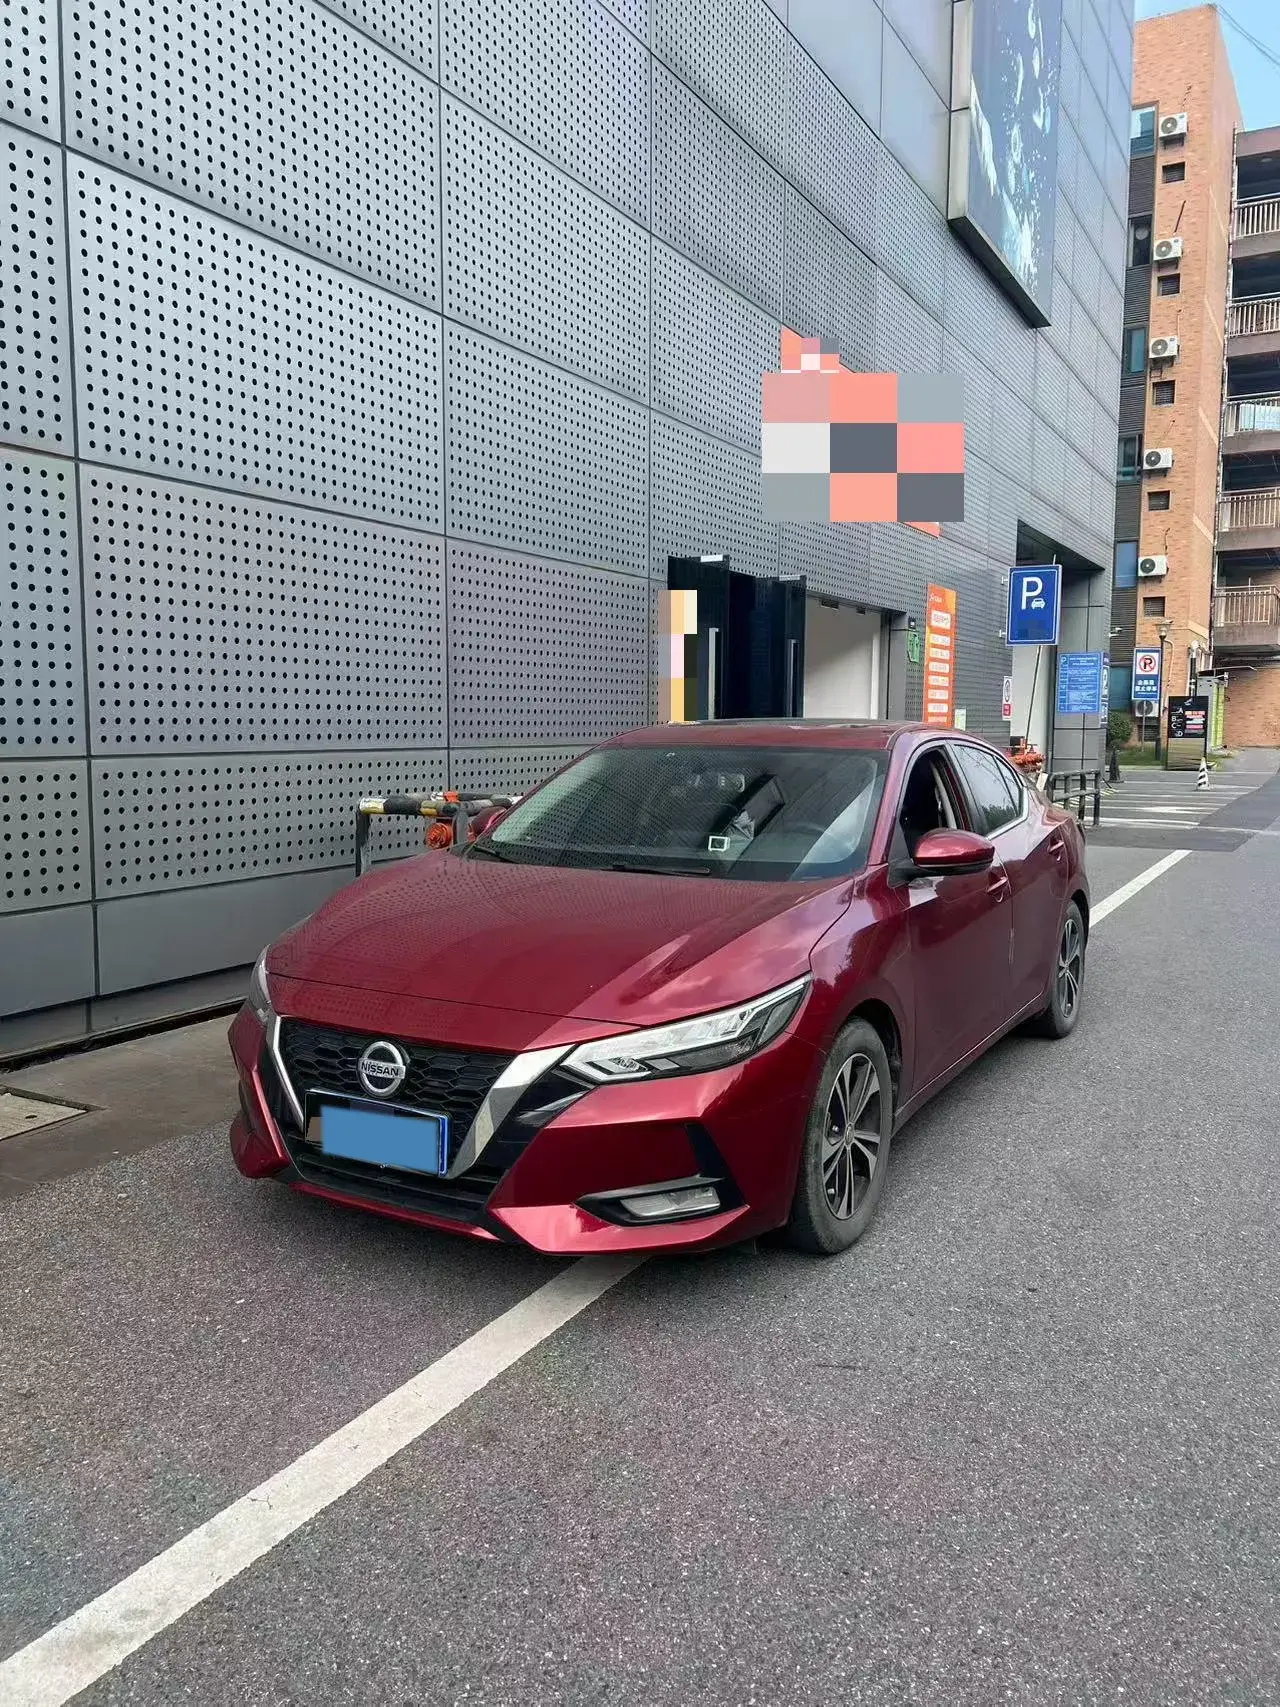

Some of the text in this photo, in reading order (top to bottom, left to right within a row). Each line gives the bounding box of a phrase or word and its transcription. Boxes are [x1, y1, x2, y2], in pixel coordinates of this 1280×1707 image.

[1021, 576, 1043, 610] P
[1144, 658, 1153, 669] P
[361, 1062, 399, 1076] NISSAN
